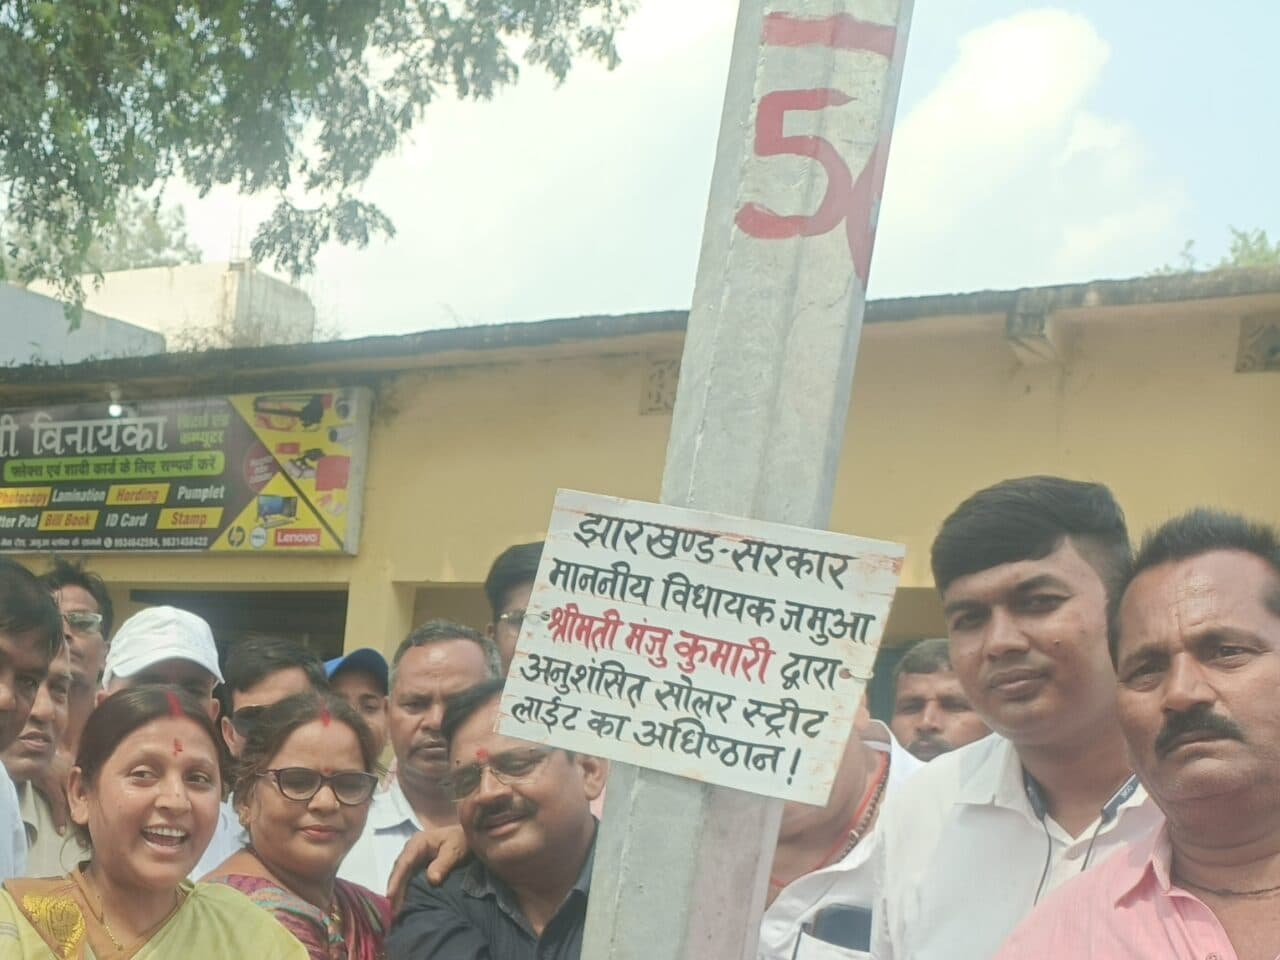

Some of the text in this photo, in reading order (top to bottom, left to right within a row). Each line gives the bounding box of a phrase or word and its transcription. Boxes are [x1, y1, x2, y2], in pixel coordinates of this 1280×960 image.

[52, 488, 106, 502] Lamination
[177, 485, 224, 503] Pumplet
[18, 513, 39, 528] Pad
[44, 513, 64, 527] Bill
[65, 512, 90, 527] Book
[105, 513, 118, 527] ID
[120, 513, 148, 528] Card
[171, 511, 207, 528] Stamp
[277, 530, 318, 544] Lenovo
[549, 557, 876, 645] माननीय विधायक जमुआ
[547, 602, 843, 691] श्रीमती मंजु कुमारी द्वारा
[511, 695, 582, 735] लाईट
[587, 708, 632, 741] का
[520, 652, 829, 738] अनुशंसित सोलर स्ट्रीट
